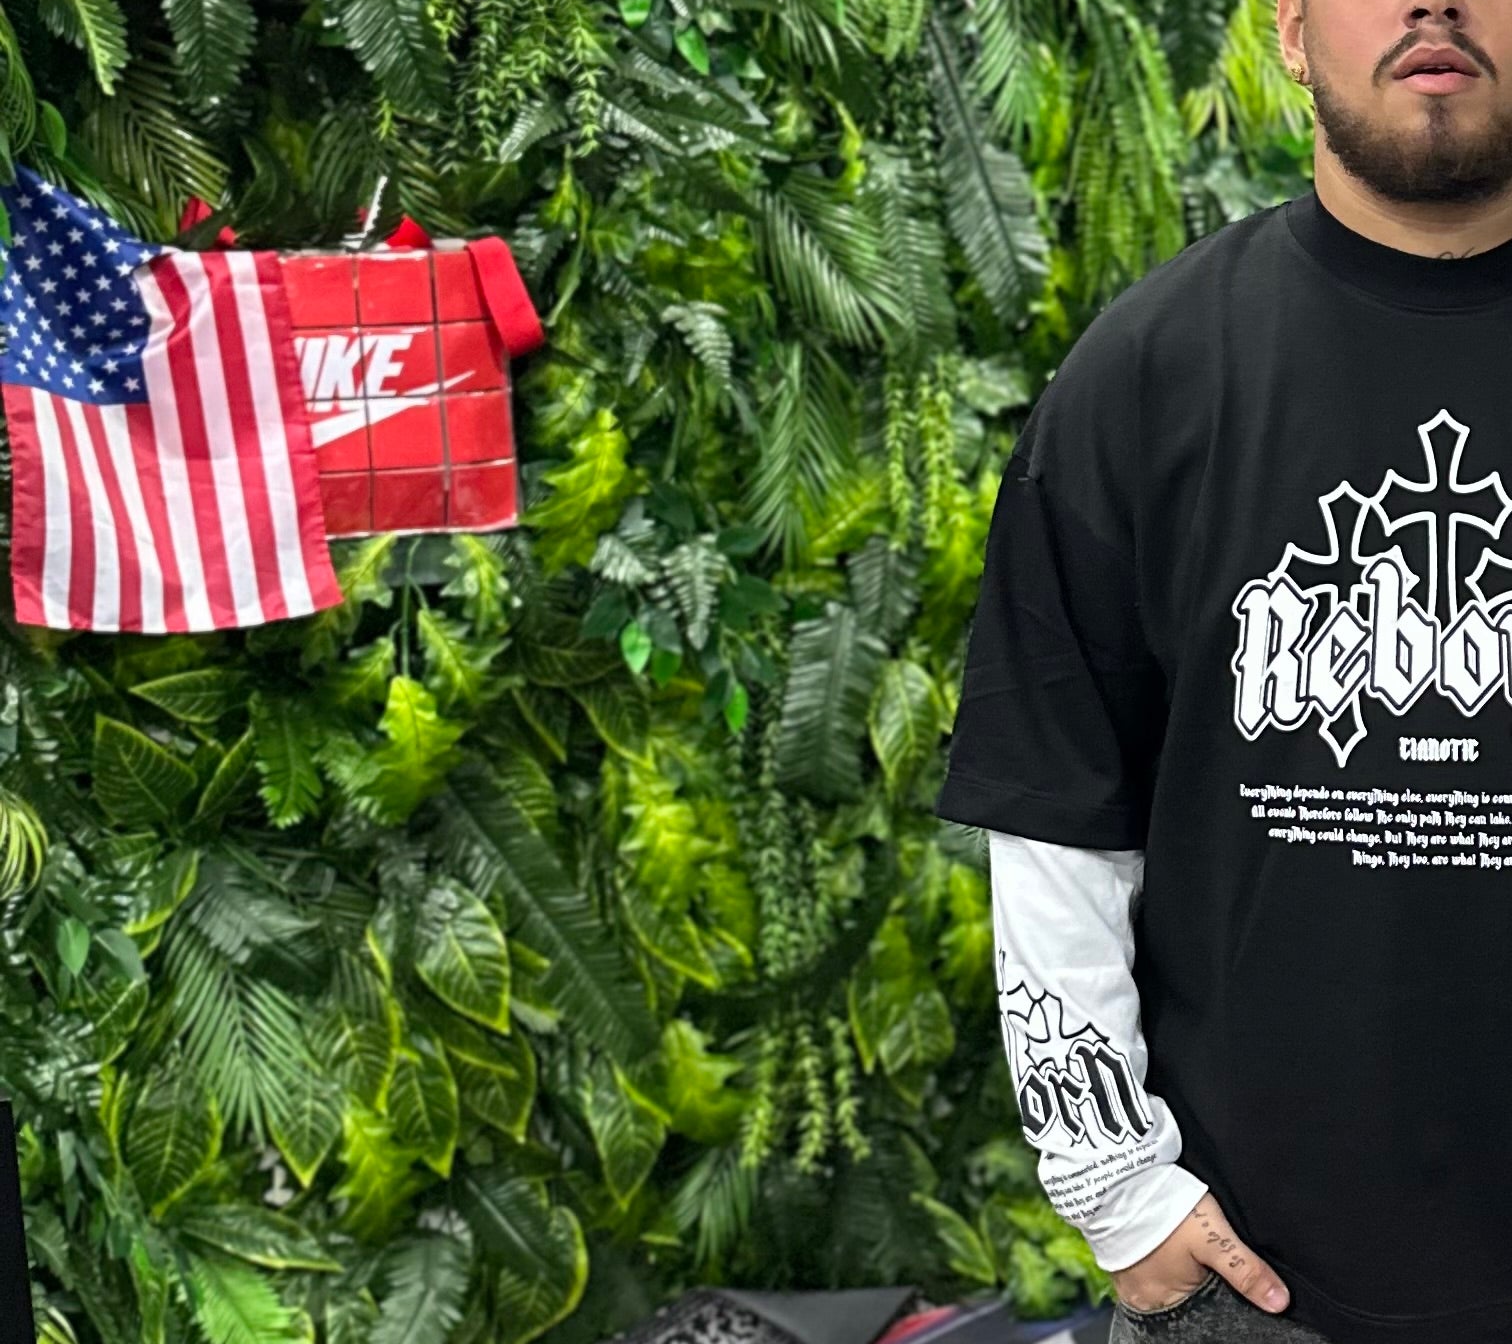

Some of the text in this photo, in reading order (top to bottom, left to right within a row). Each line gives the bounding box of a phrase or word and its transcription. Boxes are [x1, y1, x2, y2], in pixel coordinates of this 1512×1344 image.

[293, 333, 413, 412] IKE
[1240, 784, 1292, 802] Everything
[1331, 790, 1344, 800] on
[1346, 788, 1399, 806] everything
[1317, 828, 1344, 841] could
[1431, 835, 1447, 844] are
[1450, 832, 1474, 845] what
[1432, 856, 1448, 865] are
[1452, 853, 1476, 865] what
